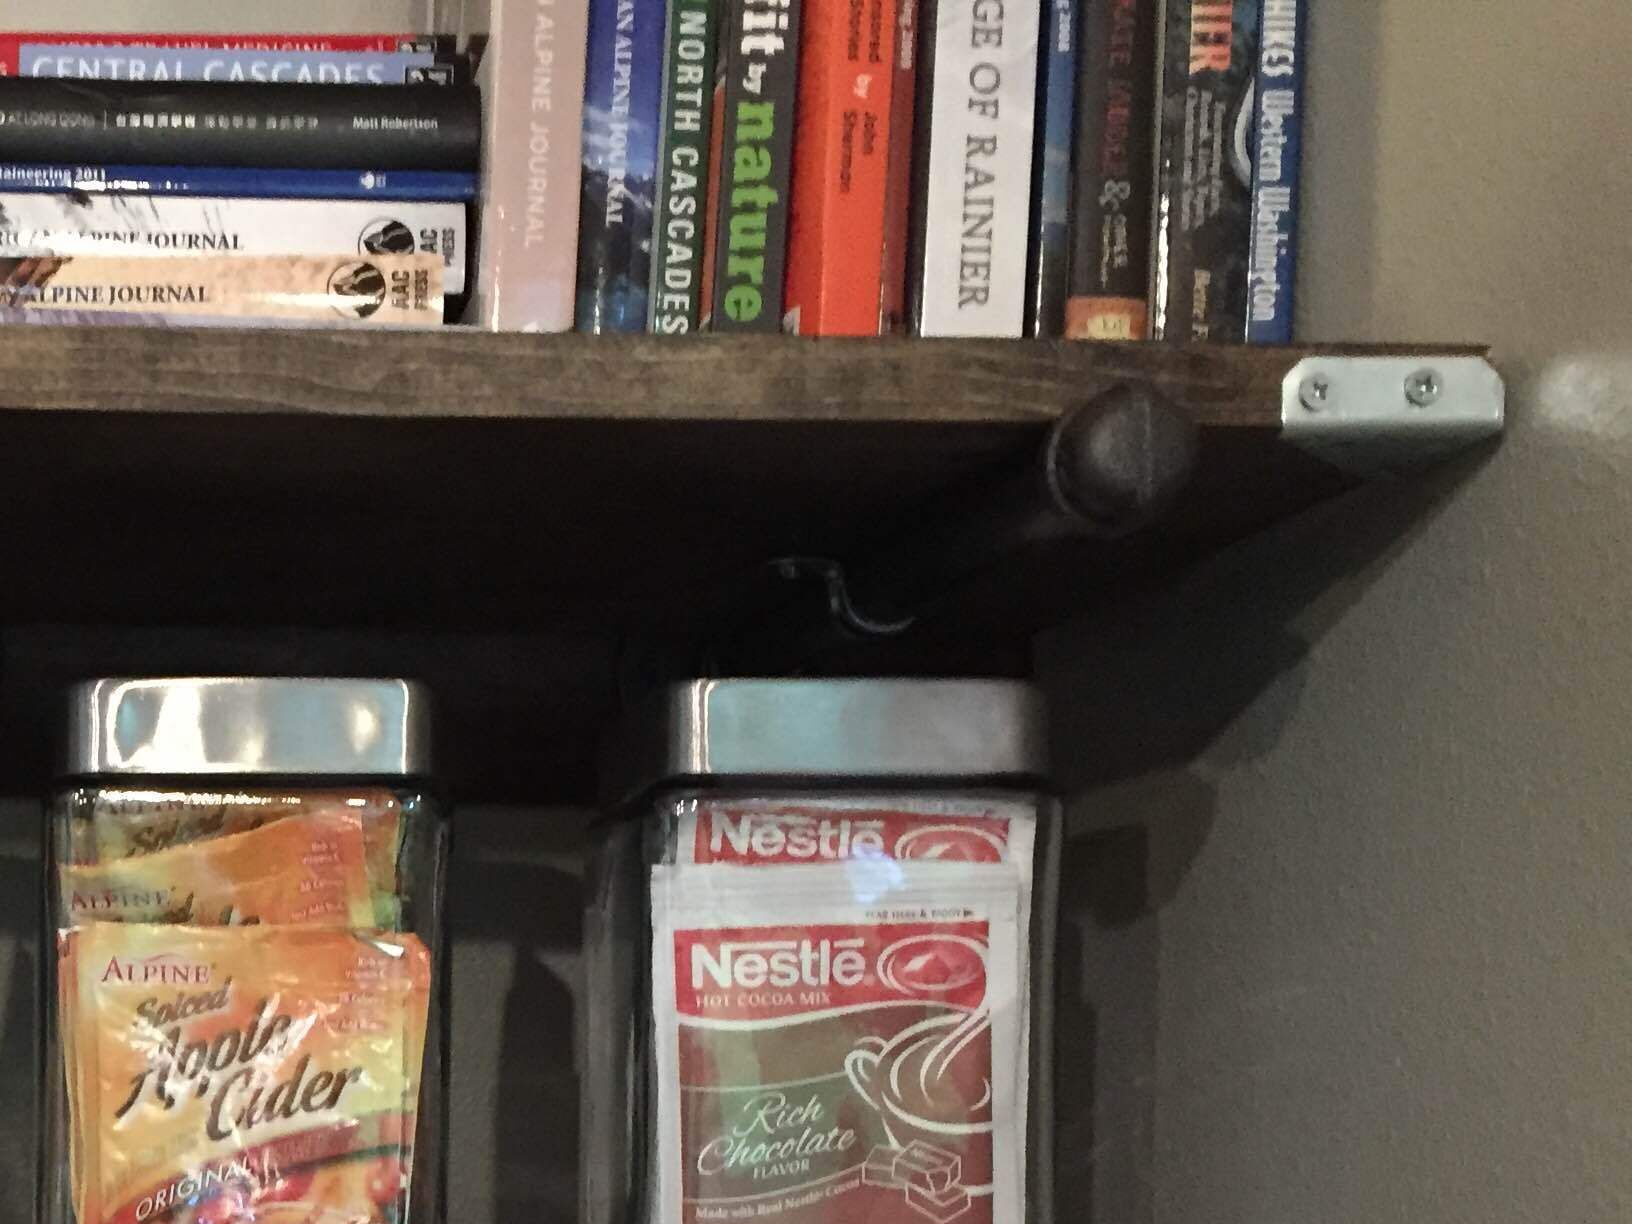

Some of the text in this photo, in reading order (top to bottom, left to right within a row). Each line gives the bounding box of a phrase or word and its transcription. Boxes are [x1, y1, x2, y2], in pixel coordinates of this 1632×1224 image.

[31, 56, 386, 84] CENTRAL CASCADES
[611, 36, 633, 114] ALPINE
[742, 62, 768, 96] by
[969, 62, 1002, 120] OF
[524, 14, 555, 249] ALPINE JOURNAL
[839, 110, 859, 194] Sherman
[1258, 89, 1296, 182] Western
[605, 122, 627, 228] JOURNAL
[661, 10, 707, 336] NORTH CASCADES
[146, 231, 244, 251] JOURNAL
[420, 228, 438, 254] AC
[724, 101, 780, 323] nature
[957, 133, 999, 311] RAINIER
[1250, 186, 1292, 321] Washington
[108, 285, 211, 305] JOURNAL
[101, 954, 211, 985] ALPINE
[695, 990, 831, 1009] HOT COCOA MIX
[205, 1055, 365, 1142] Cider
[733, 1092, 824, 1138] Rich
[697, 1126, 858, 1176] Chocolate
[753, 1158, 811, 1180] FLAVOR
[135, 1156, 254, 1223] ORIGINAL
